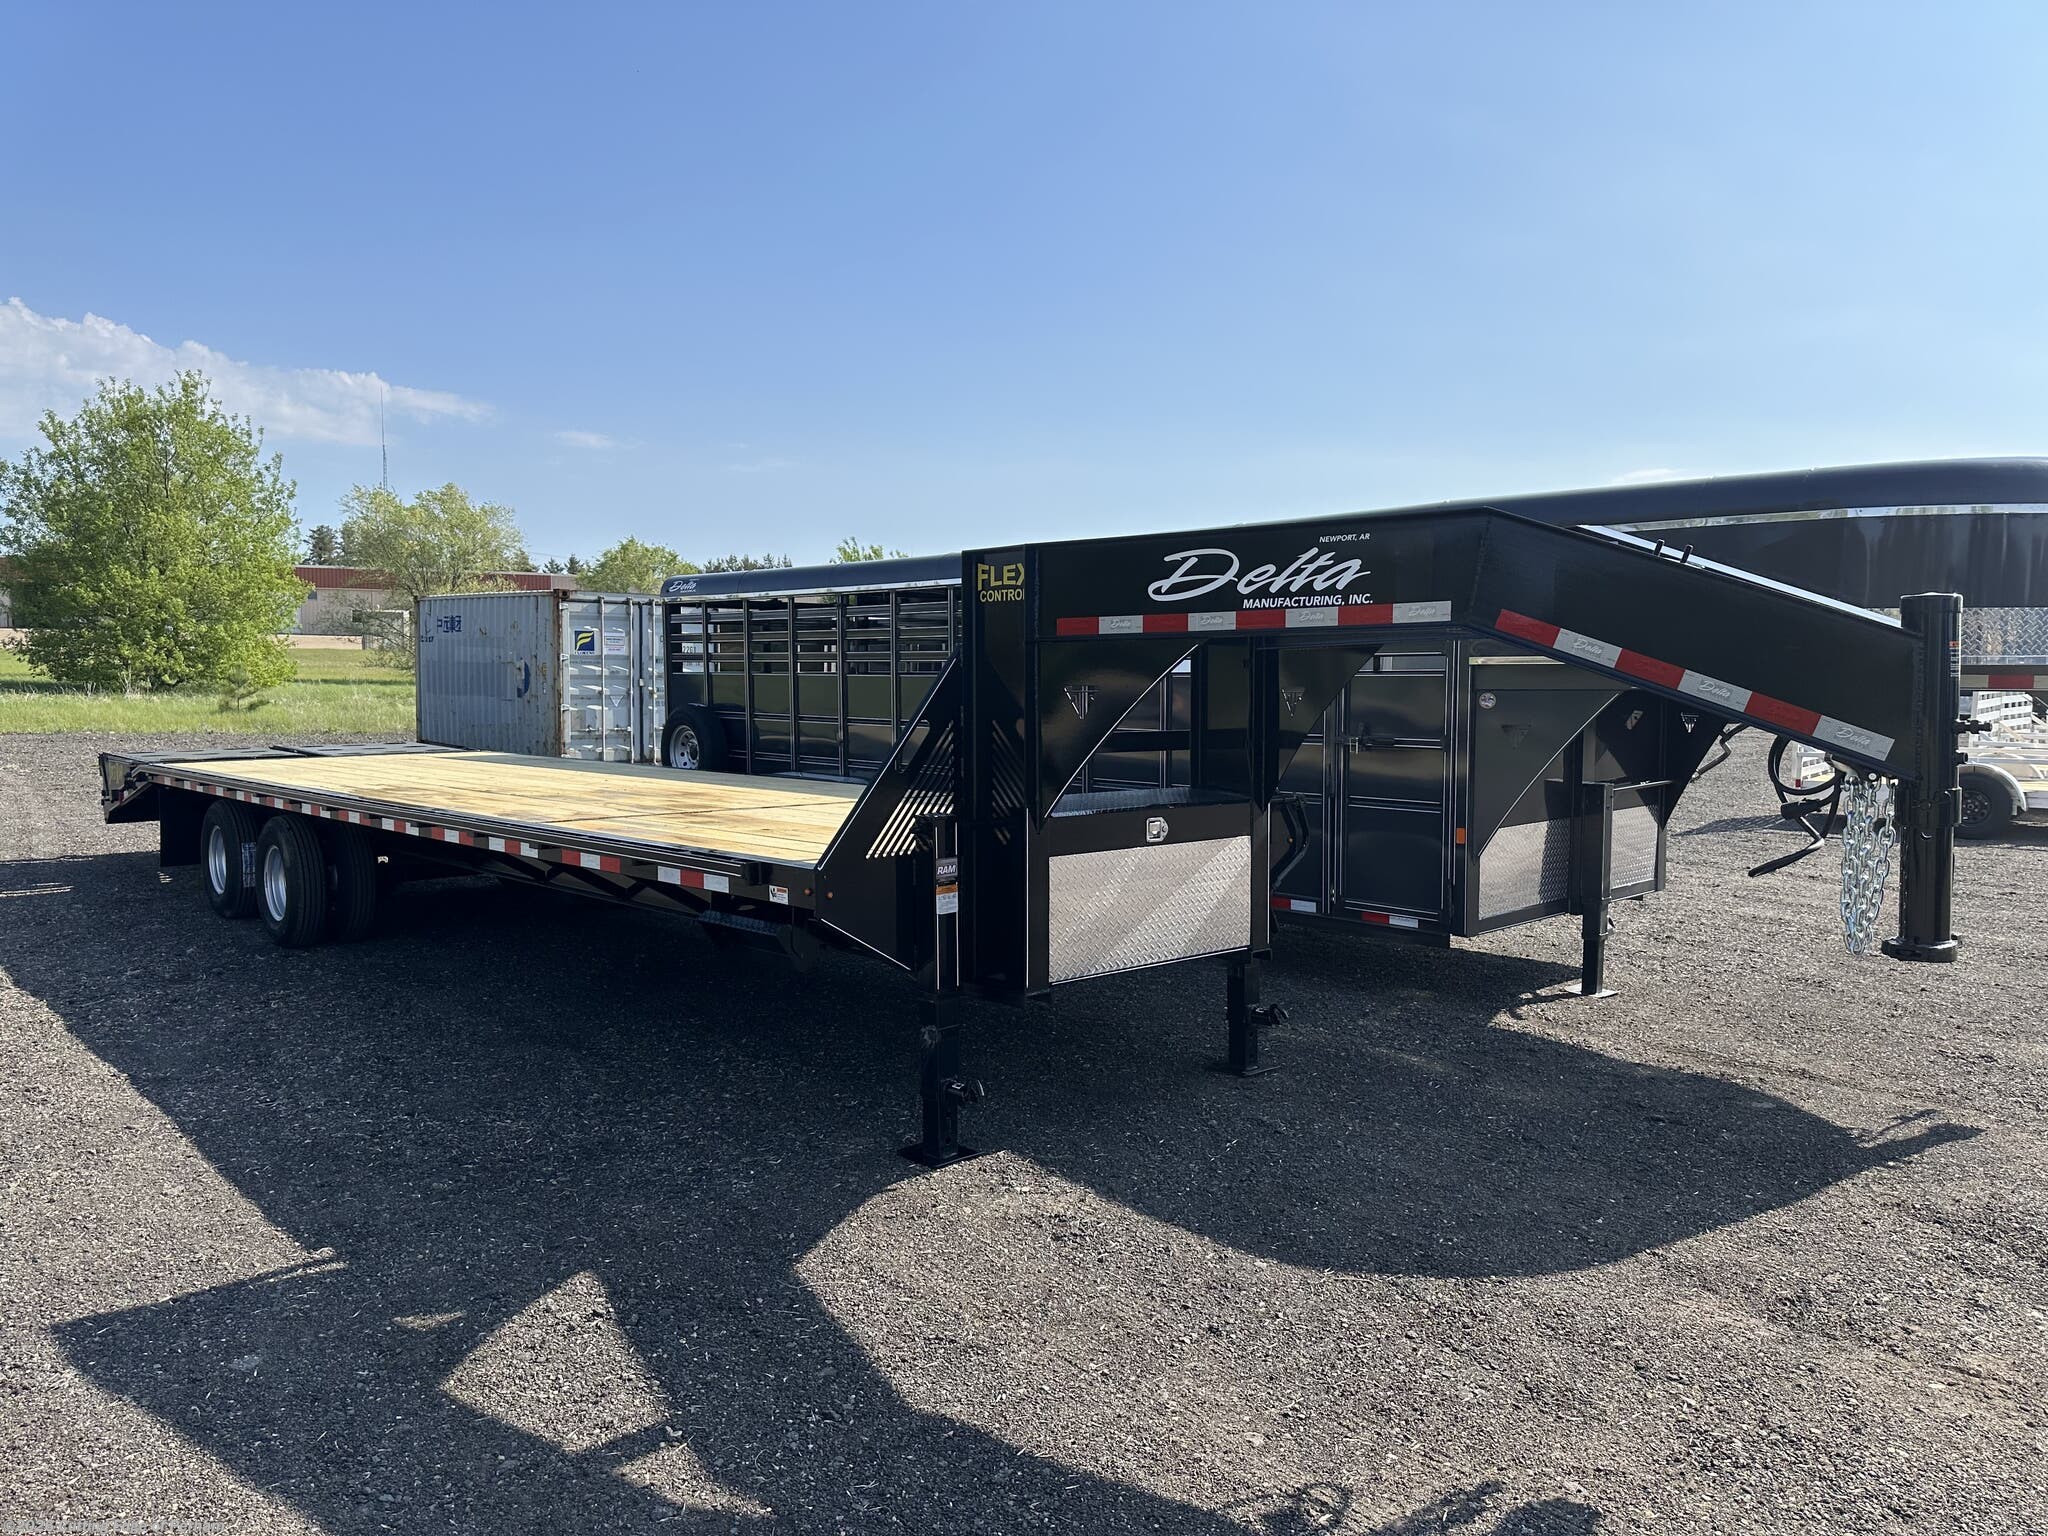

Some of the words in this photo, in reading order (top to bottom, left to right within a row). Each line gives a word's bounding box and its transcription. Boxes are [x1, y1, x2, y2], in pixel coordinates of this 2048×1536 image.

[1319, 533, 1358, 543] NEWPORT,
[1359, 532, 1371, 541] AR
[1147, 546, 1372, 602] Delta
[979, 588, 1025, 603] CONTRO
[1242, 594, 1345, 609] MANUFACTURING,
[1348, 593, 1374, 605] INC.
[937, 864, 956, 875] RAM
